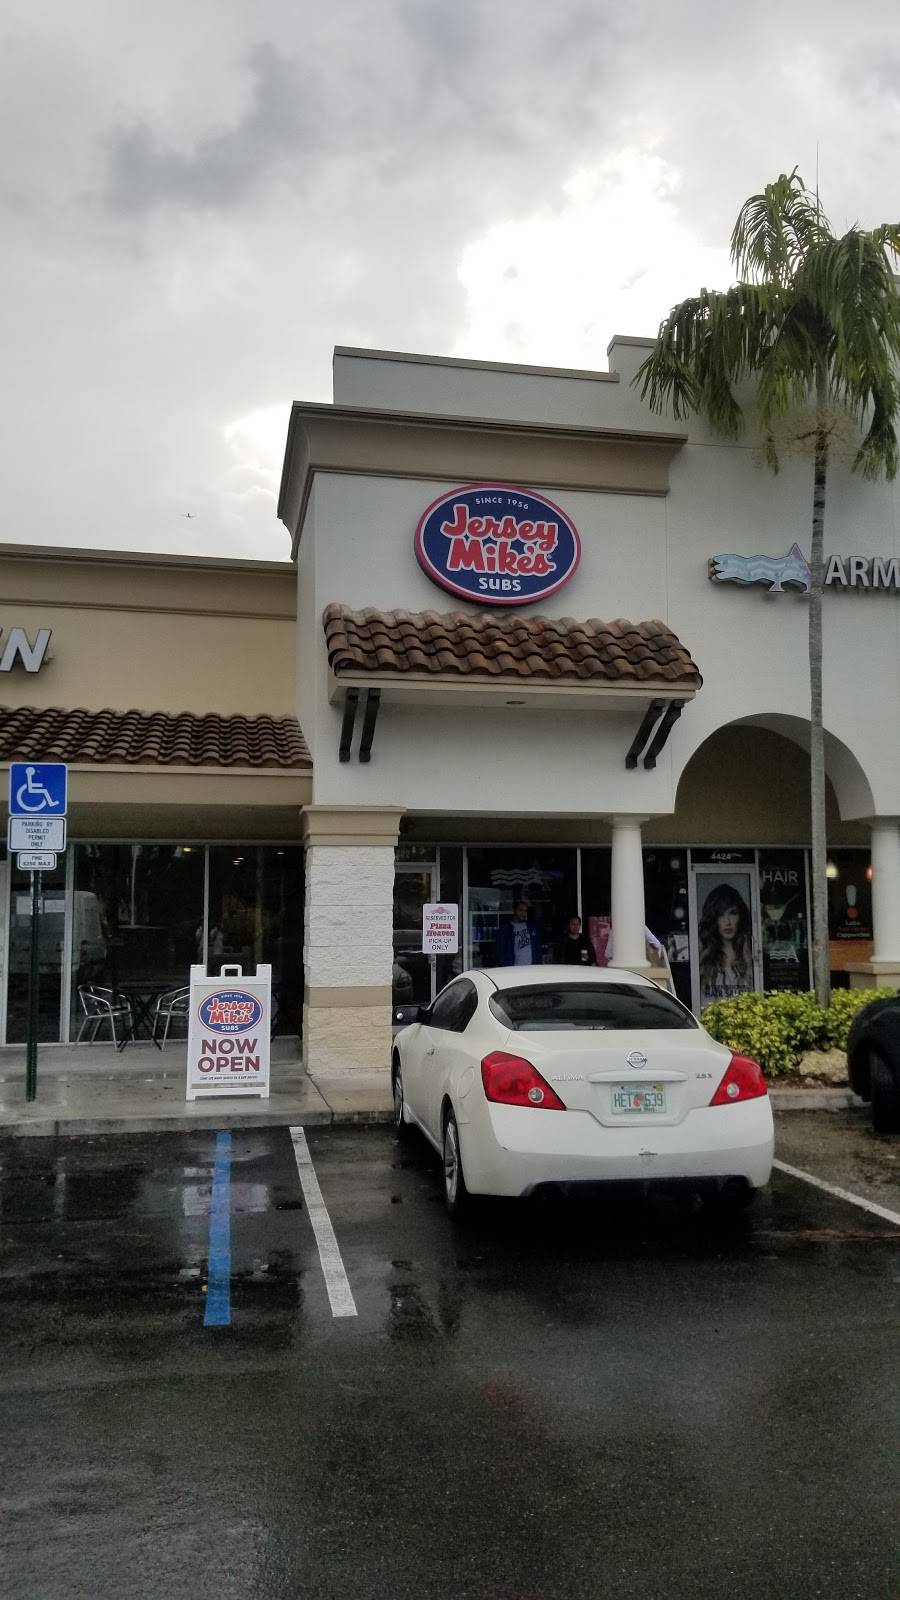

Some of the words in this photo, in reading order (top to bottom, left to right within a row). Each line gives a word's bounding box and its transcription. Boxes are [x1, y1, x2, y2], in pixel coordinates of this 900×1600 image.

[475, 497, 503, 505] SINCE
[507, 498, 529, 510] 1956
[440, 504, 558, 552] Jersey
[447, 538, 557, 576] Mike's
[479, 577, 522, 591] SUBS
[762, 870, 798, 883] HAIR
[425, 929, 456, 937] Heaven
[429, 922, 452, 930] Pizza
[207, 997, 254, 1013] Jersey
[209, 1010, 253, 1024] Mike's
[201, 1039, 258, 1054] NOW
[197, 1056, 260, 1072] OPEN
[614, 1092, 632, 1107] HET
